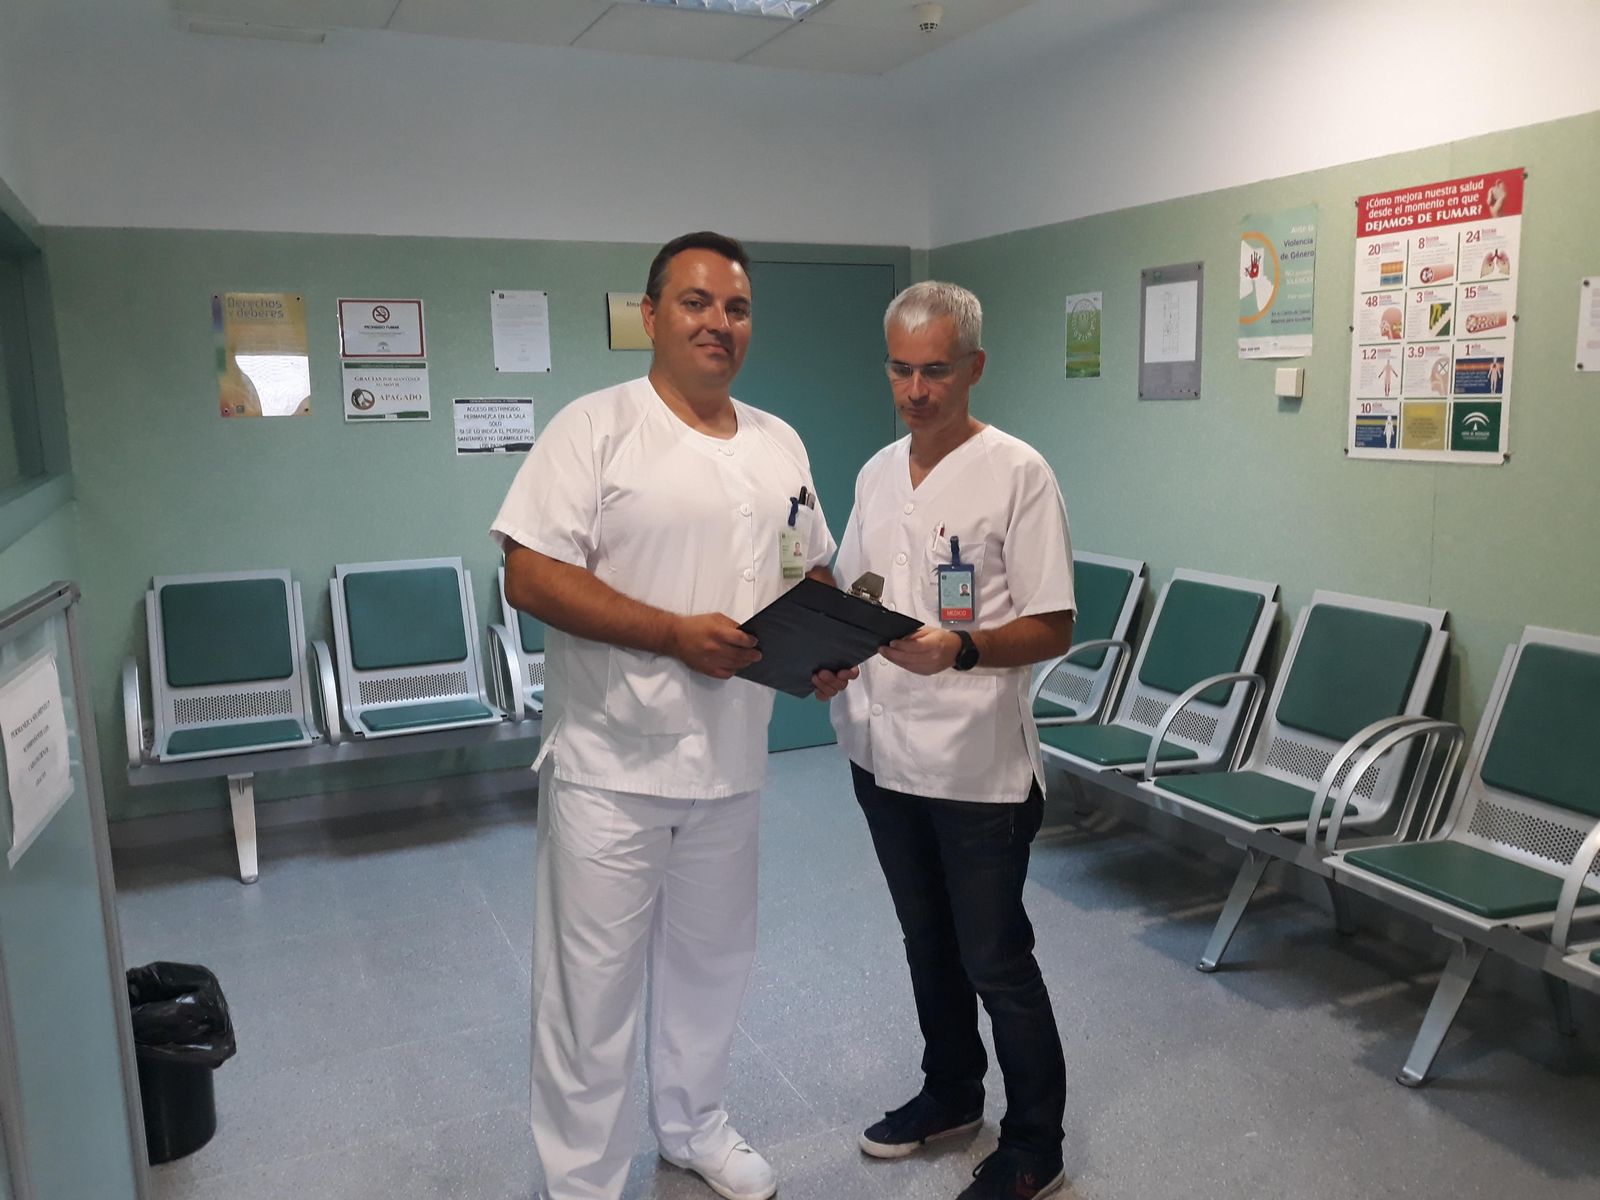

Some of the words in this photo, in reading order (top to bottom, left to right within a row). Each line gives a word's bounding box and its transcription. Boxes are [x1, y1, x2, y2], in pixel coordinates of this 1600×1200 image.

[1366, 197, 1392, 210] ¿Cómo
[1394, 192, 1422, 204] mejora
[1425, 186, 1457, 198] nuestra
[1460, 180, 1484, 192] salud
[1369, 206, 1392, 219] desde
[1395, 205, 1402, 214] el
[1404, 199, 1445, 213] momento
[1447, 197, 1459, 206] en
[1461, 193, 1480, 205] que
[1365, 215, 1414, 232] DEJAMOS
[1417, 212, 1433, 224] DE
[1436, 205, 1483, 221] FUMAR?
[1284, 238, 1314, 247] Violencia
[1466, 230, 1480, 243] 24
[1418, 237, 1425, 249] 8
[1290, 250, 1315, 260] Género
[1368, 244, 1381, 256] 20
[1416, 292, 1423, 303] 3
[1464, 287, 1477, 299] 15
[227, 296, 282, 308] Derechos
[1365, 295, 1378, 307] 48
[237, 307, 284, 318] deberes
[1362, 348, 1377, 360] 1.2
[1408, 346, 1425, 358] 3.9
[1465, 344, 1471, 356] 1
[1361, 403, 1371, 413] 10
